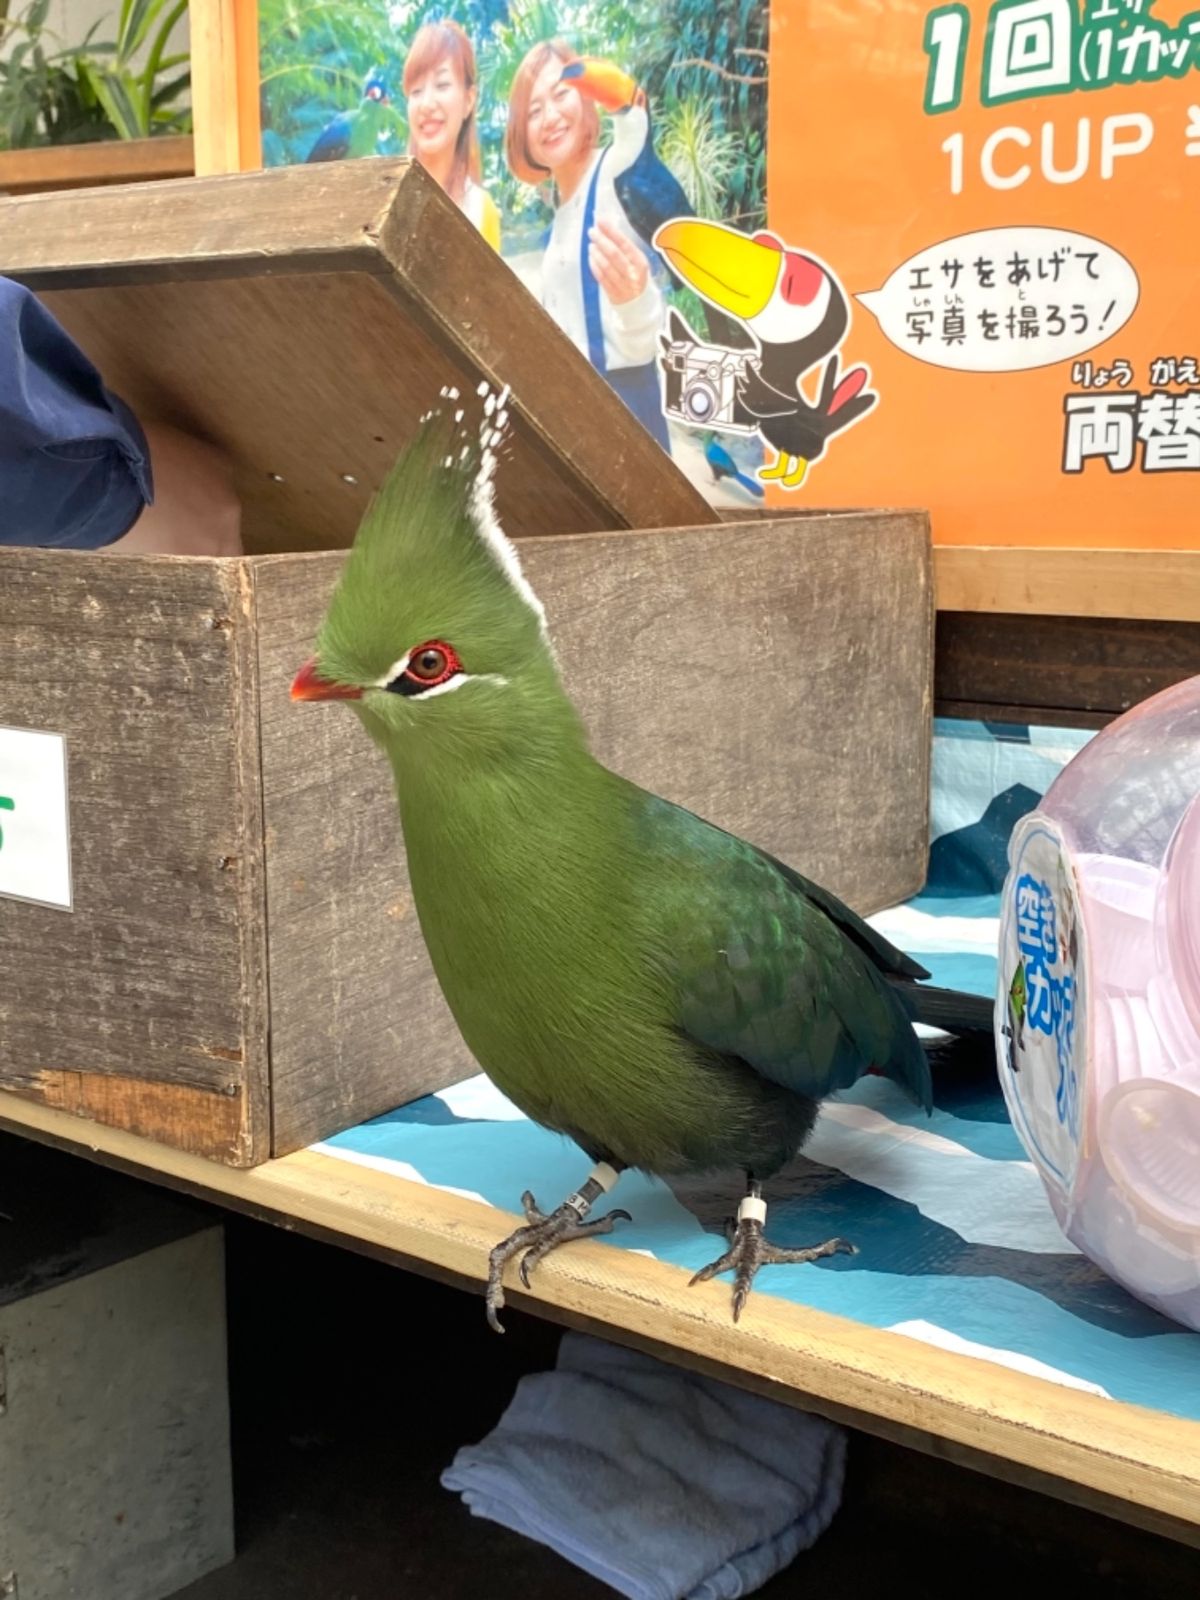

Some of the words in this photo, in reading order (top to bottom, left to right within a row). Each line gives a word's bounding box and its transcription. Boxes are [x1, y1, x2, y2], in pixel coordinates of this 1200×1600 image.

[1078, 20, 1200, 82] (1カッ
[908, 246, 1100, 290] エサをあげて
